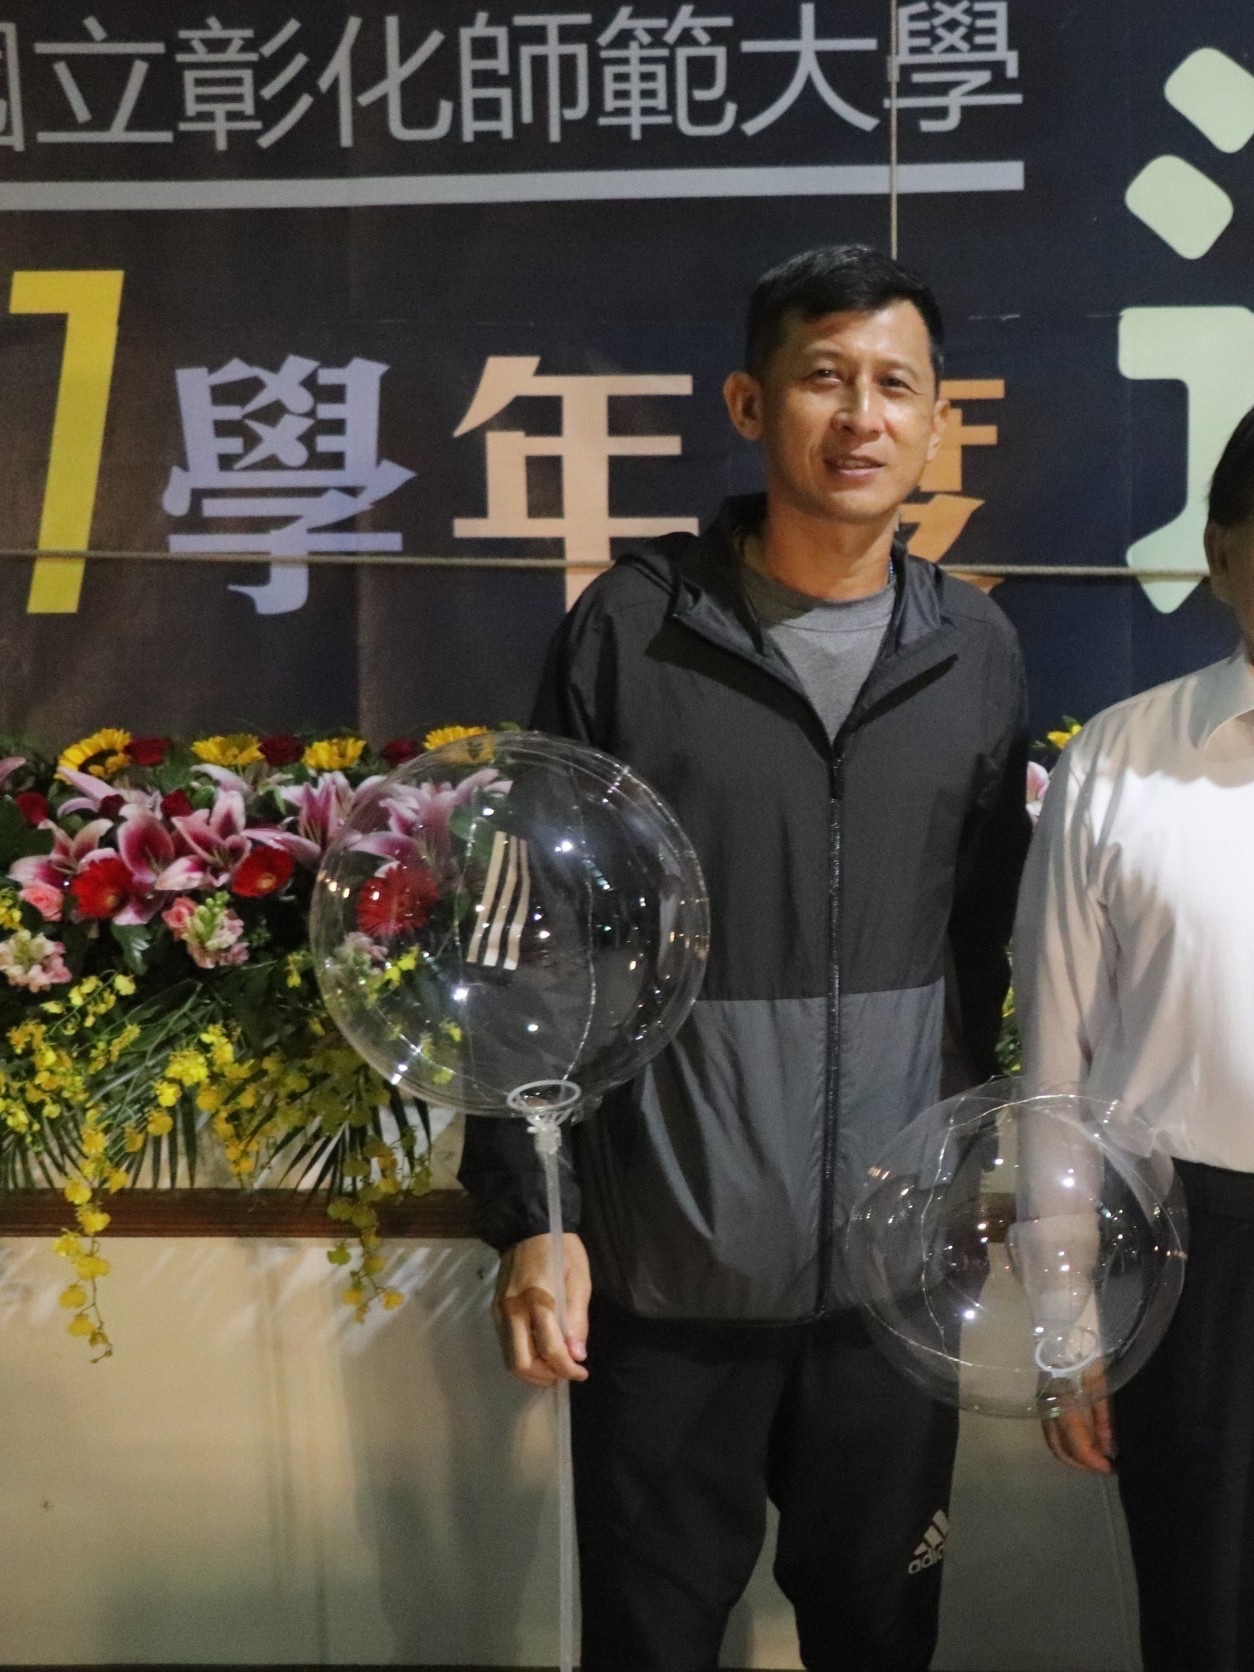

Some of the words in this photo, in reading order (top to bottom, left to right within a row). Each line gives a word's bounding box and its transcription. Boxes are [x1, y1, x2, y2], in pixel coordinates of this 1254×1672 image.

[0, 1, 1024, 152] 立彰化師範大學
